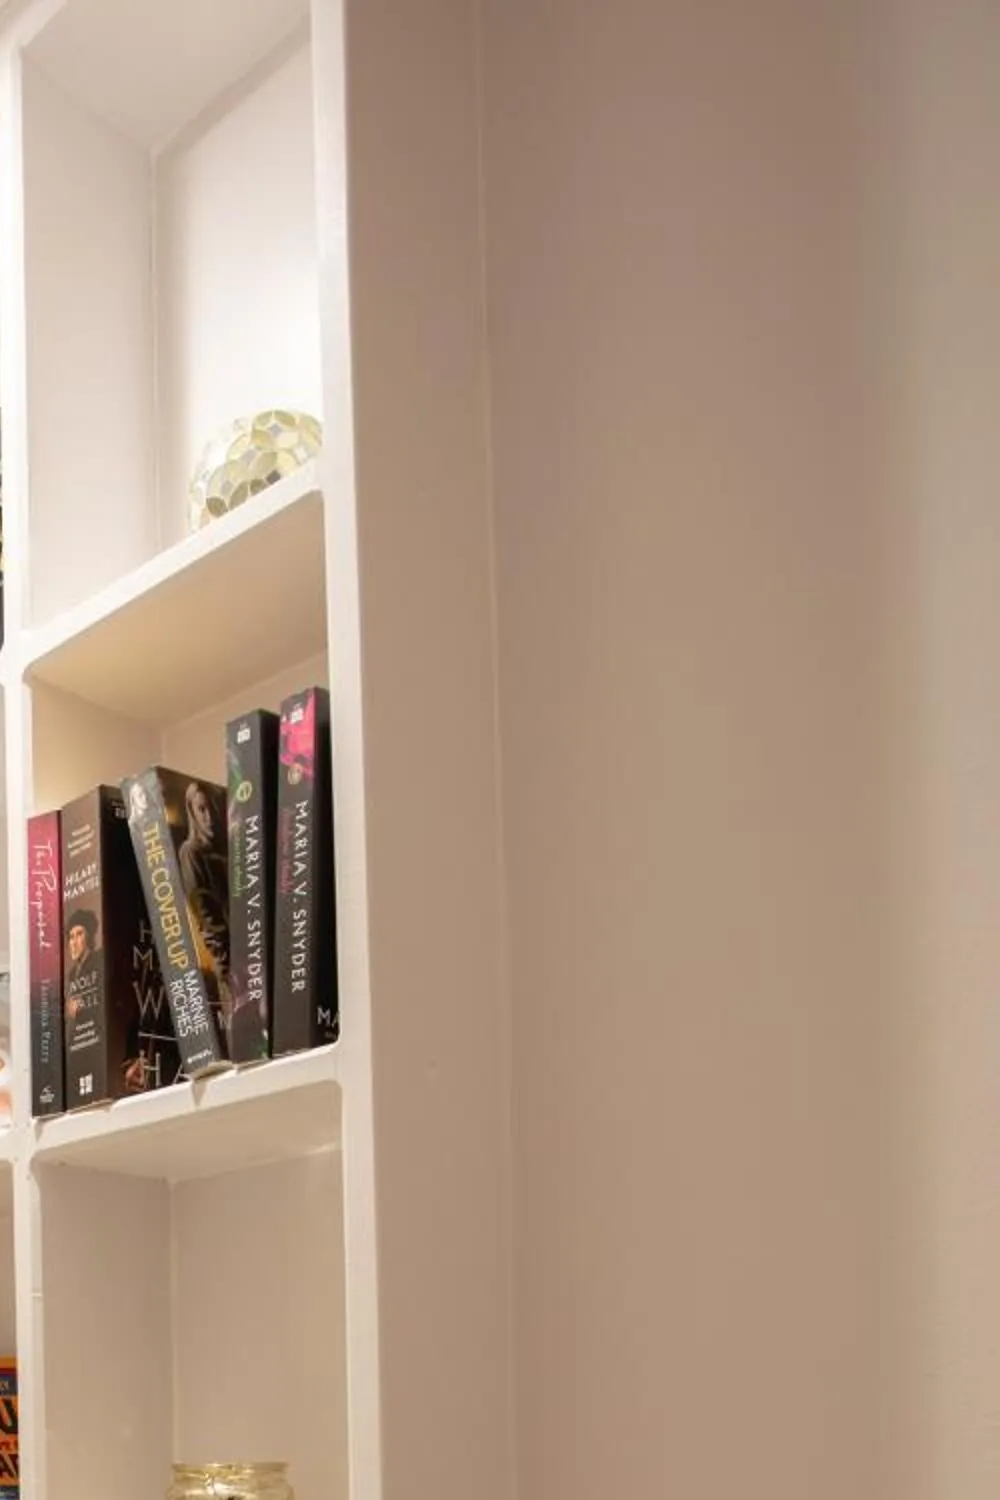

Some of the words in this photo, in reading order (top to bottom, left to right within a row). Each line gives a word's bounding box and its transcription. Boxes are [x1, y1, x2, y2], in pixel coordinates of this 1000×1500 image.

[142, 821, 165, 868] THE
[245, 814, 260, 889] MARIA
[292, 799, 308, 877] MARIA
[152, 866, 182, 942] COVER
[247, 893, 261, 914] V.
[292, 881, 307, 903] V.
[166, 938, 189, 970] UP
[247, 919, 263, 1002] SNYDER
[291, 909, 307, 993] SNYDER
[170, 979, 193, 1038] RICHES
[184, 968, 209, 1036] MARNIE
